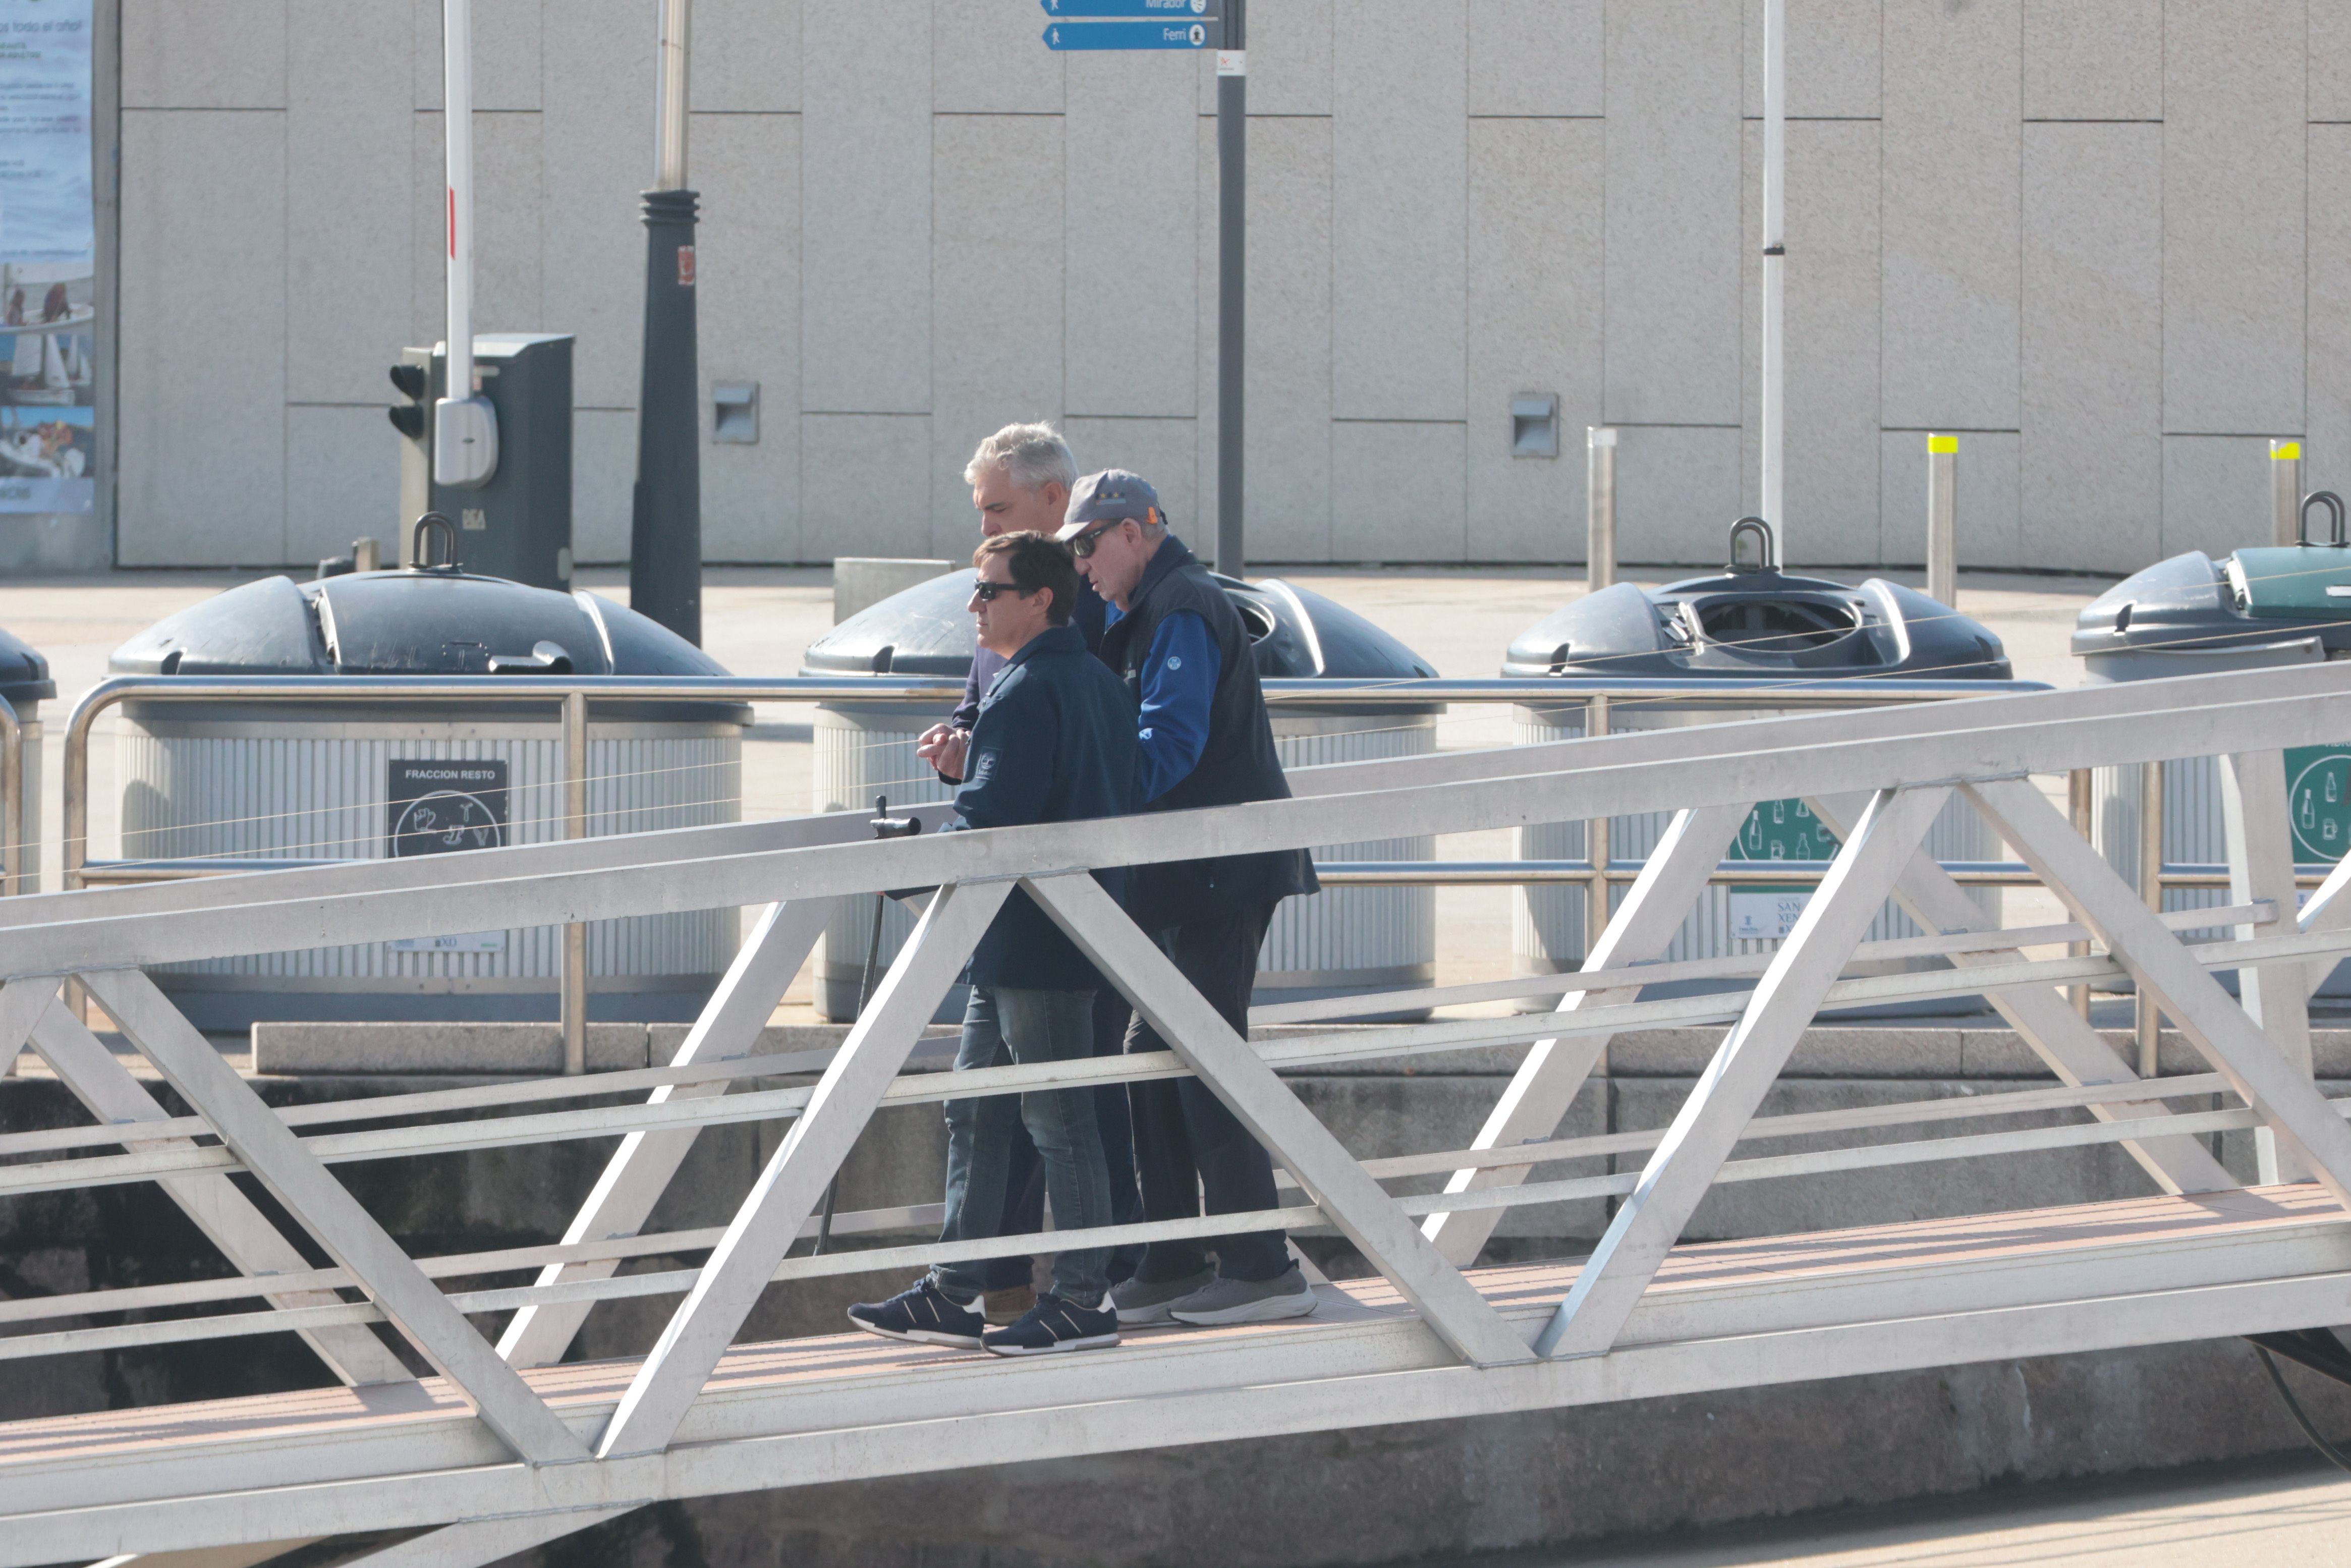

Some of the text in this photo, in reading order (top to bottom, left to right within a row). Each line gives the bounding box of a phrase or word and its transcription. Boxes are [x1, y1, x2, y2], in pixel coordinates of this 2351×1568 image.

[405, 769, 495, 780] FRACCION RESTO
[1777, 902, 1801, 912] SAN
[1777, 913, 1800, 923] XEN
